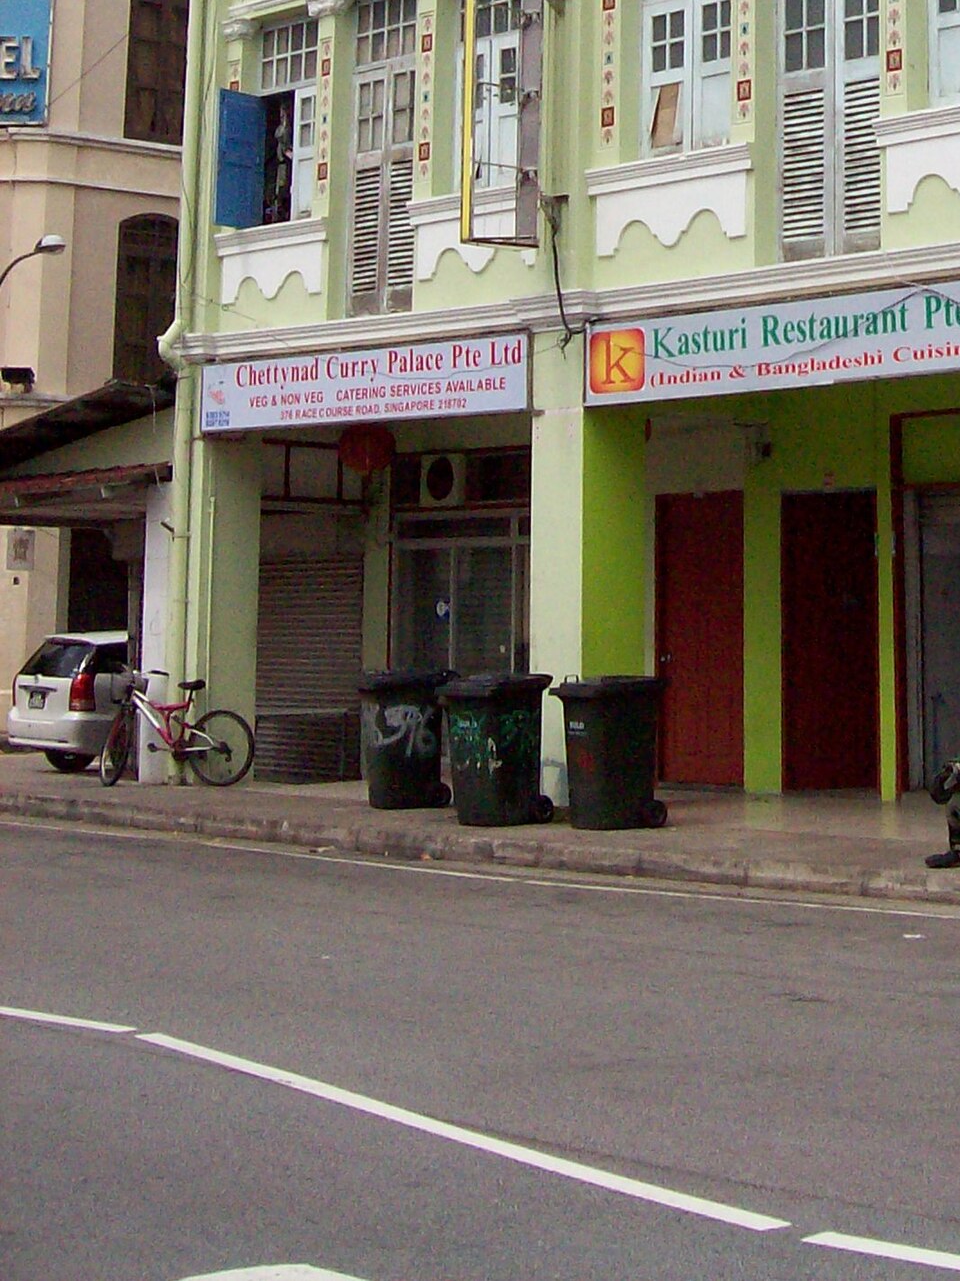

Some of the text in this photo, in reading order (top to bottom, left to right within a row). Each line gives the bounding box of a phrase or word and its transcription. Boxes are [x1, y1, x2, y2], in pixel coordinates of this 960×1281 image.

[652, 317, 747, 359] Kasturi
[762, 303, 909, 347] Restaurant
[236, 339, 522, 390] Chettynad Curry Palace Pte Ltd
[650, 368, 721, 388] (Indian
[729, 365, 746, 379] &
[756, 349, 883, 377] Bangladeshi
[250, 377, 506, 408] VEG & NON VEG CATERING SERVICES AVAILABLE
[295, 408, 317, 419] RACE
[384, 399, 435, 413] SINGAPORE
